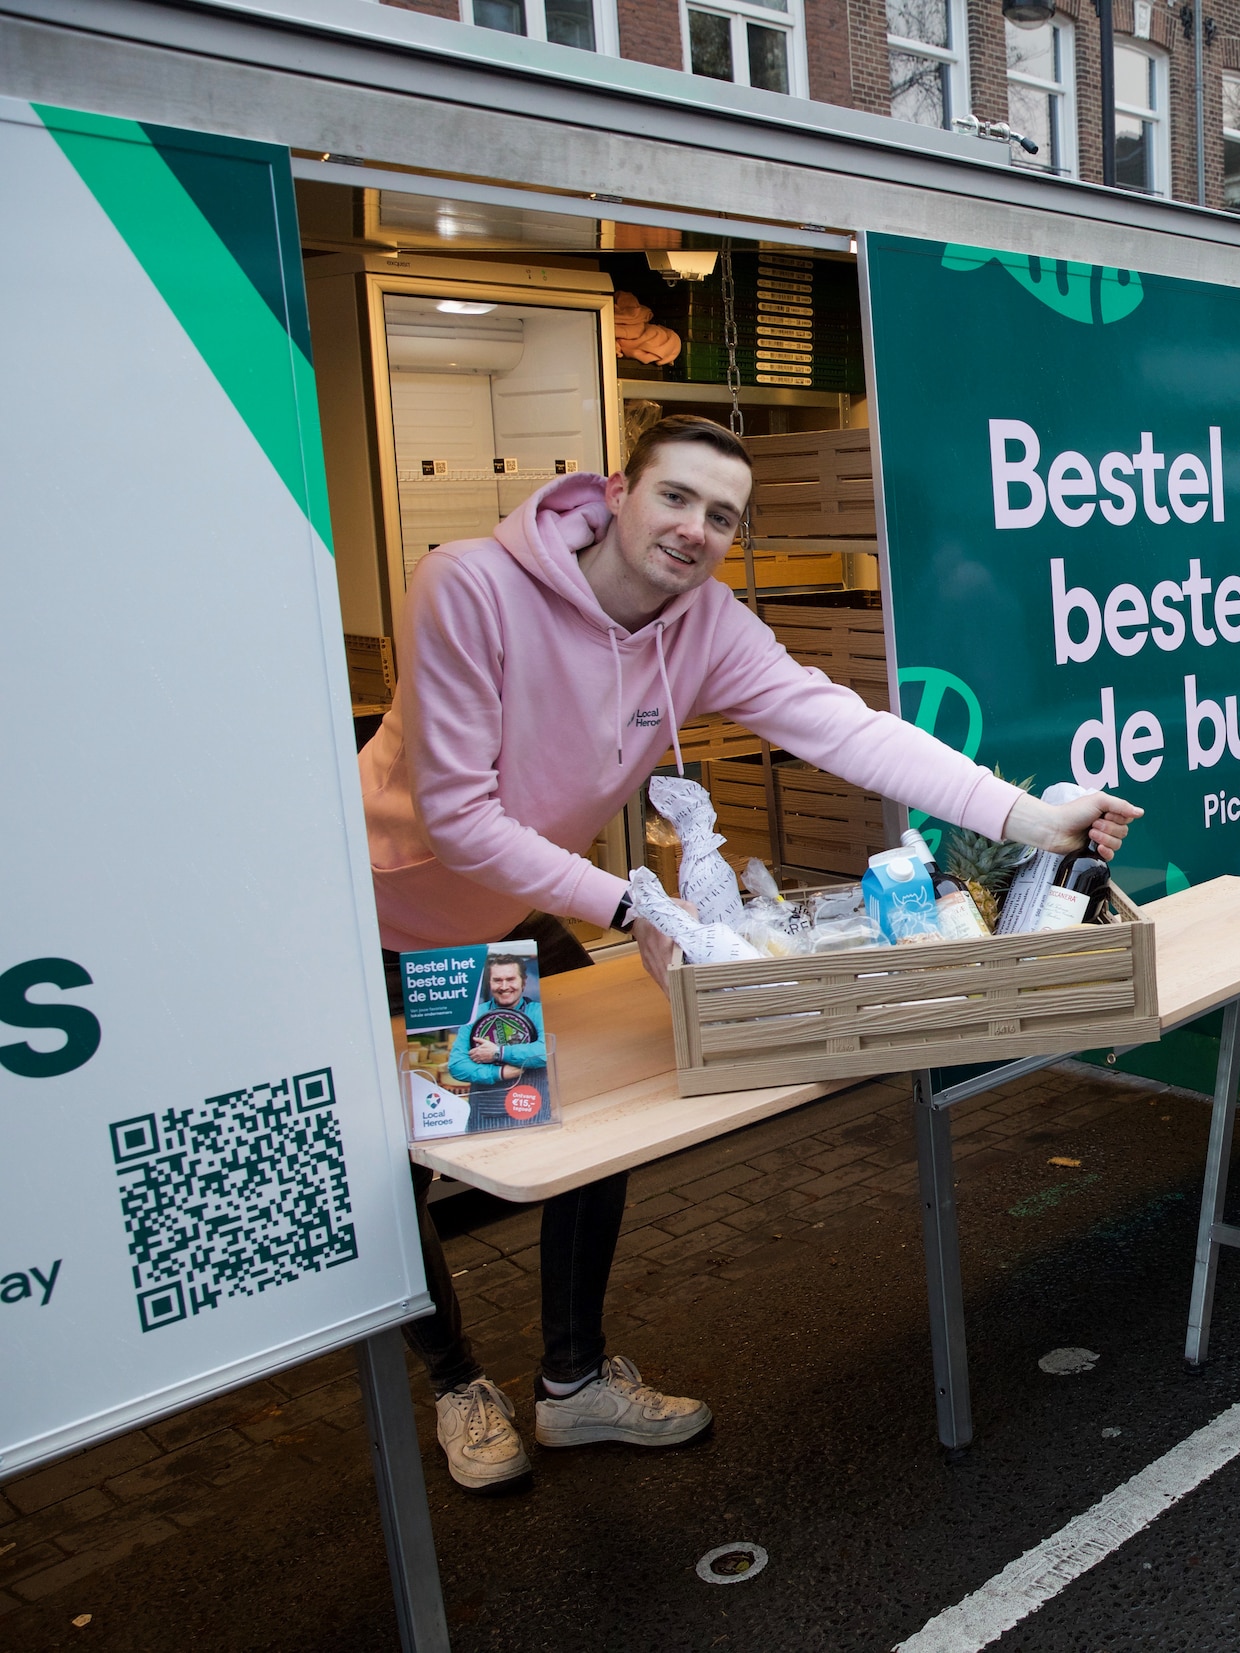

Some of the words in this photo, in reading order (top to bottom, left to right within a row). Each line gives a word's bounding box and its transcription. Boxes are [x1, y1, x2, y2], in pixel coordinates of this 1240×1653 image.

[989, 419, 1225, 529] Bestel
[636, 707, 659, 718] Local
[636, 718, 662, 727] Hero
[1070, 687, 1165, 789] de
[406, 959, 448, 974] Bestel
[451, 957, 475, 970] het
[407, 976, 446, 989] beste
[450, 972, 468, 985] uit
[408, 990, 426, 1003] de
[429, 987, 468, 1001] buurt
[512, 1092, 536, 1101] Ontvang
[422, 1110, 446, 1120] Local
[423, 1118, 453, 1128] Heroes
